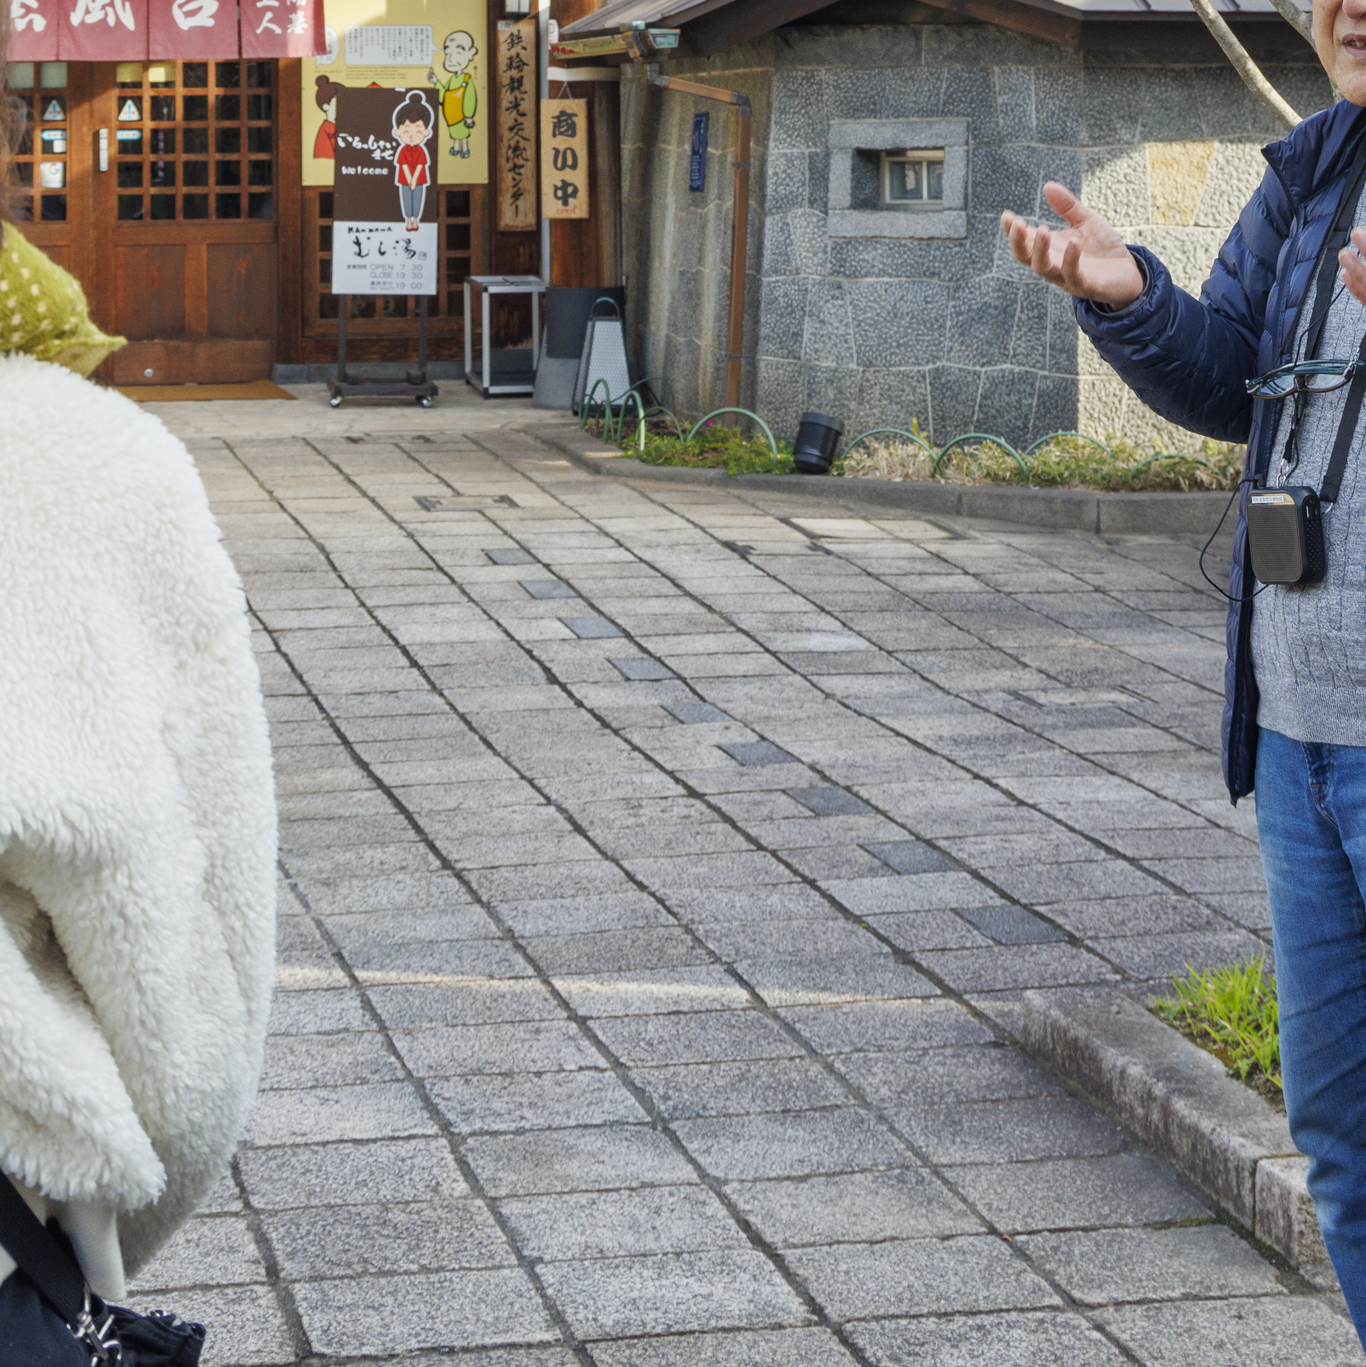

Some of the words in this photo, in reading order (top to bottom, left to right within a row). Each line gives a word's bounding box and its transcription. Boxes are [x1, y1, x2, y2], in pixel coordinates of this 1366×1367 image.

[502, 28, 531, 218] 鉄輪観光交流センター
[371, 148, 394, 160] ませ
[551, 110, 579, 207] 商い中
[341, 165, 389, 175] Welcome
[352, 235, 417, 260] むし湯
[369, 263, 394, 271] OPEN
[369, 271, 393, 280] CLOSE
